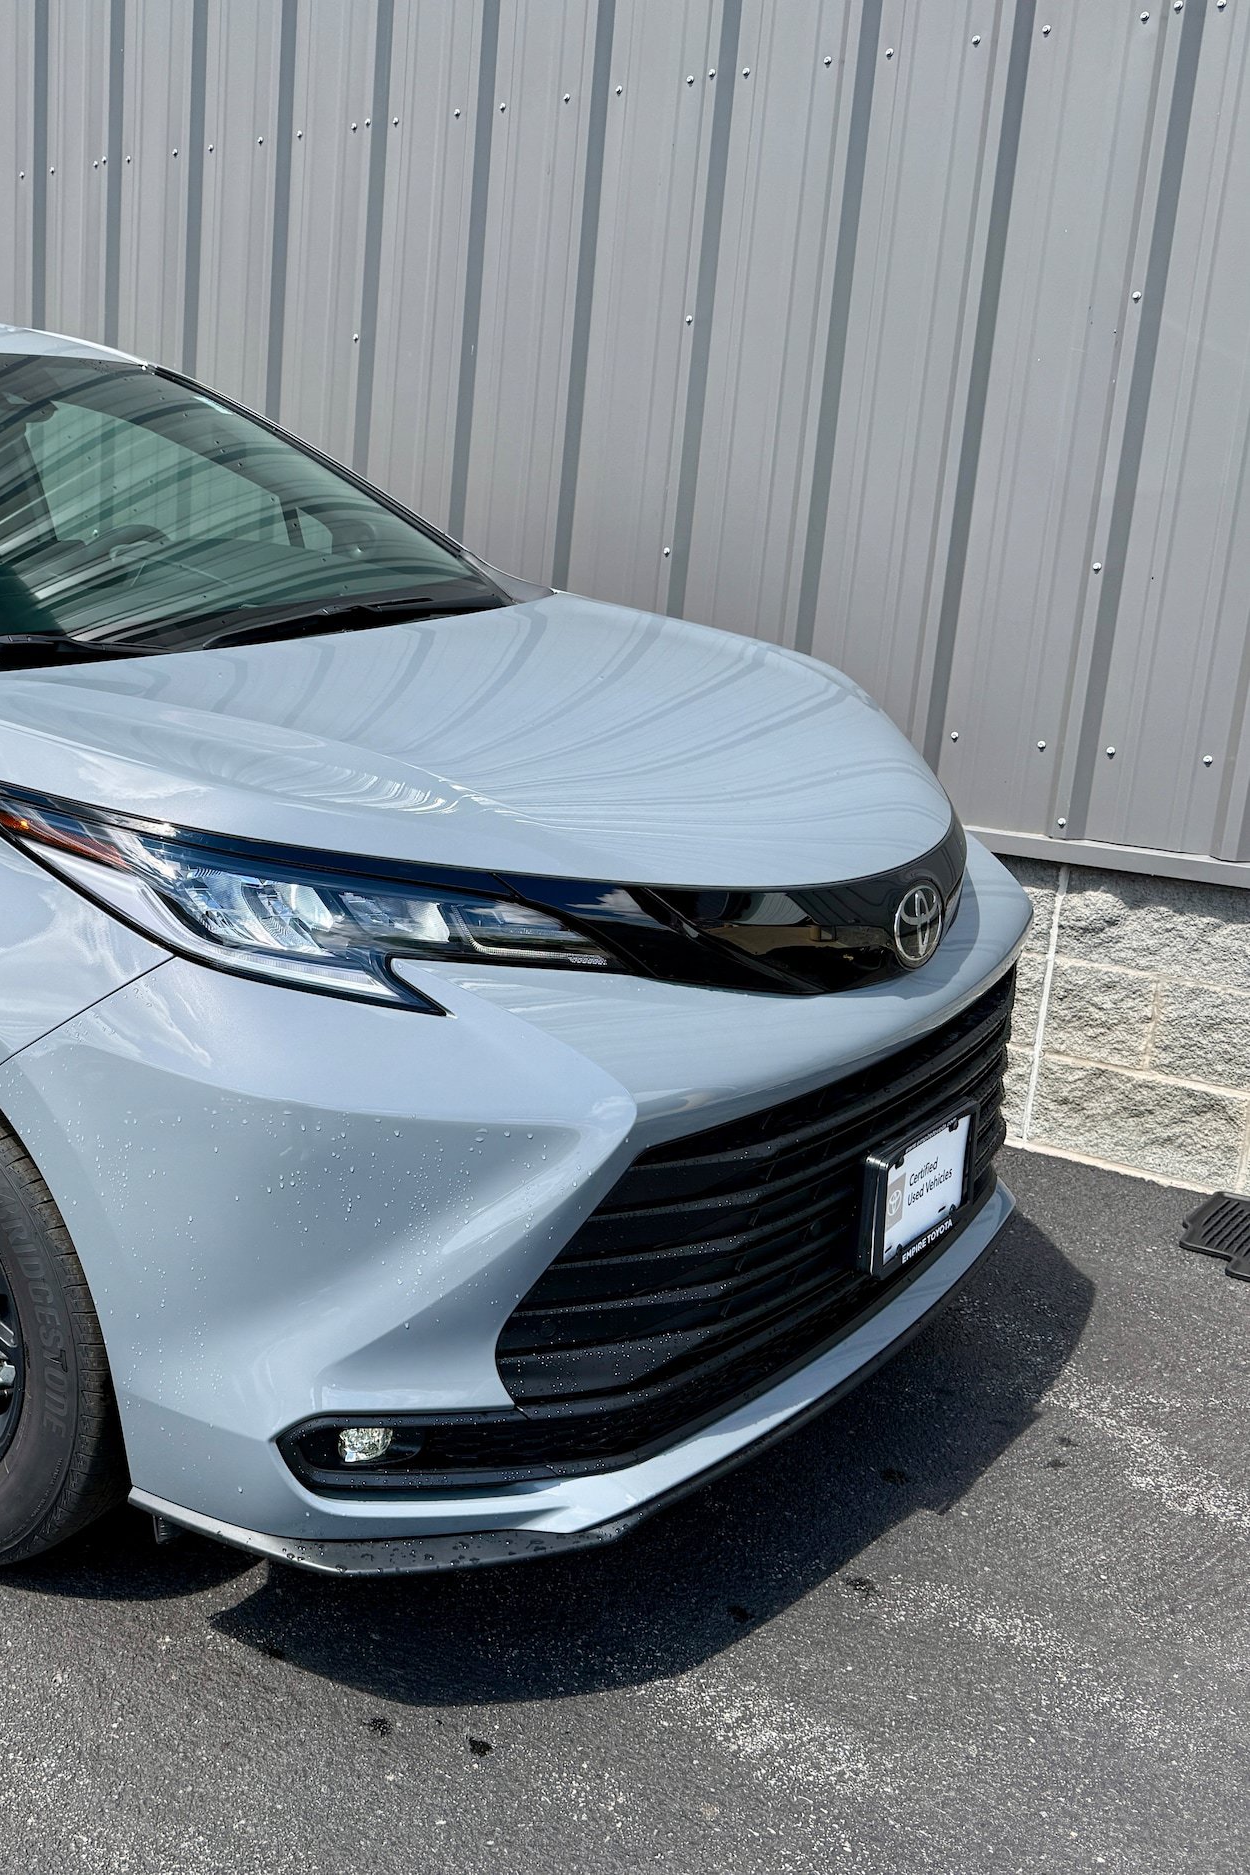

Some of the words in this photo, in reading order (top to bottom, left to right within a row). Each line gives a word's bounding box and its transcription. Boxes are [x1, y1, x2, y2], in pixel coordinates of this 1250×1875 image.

[907, 1184, 925, 1207] Used
[925, 1168, 953, 1193] Vehicles
[909, 1156, 939, 1187] Certified
[902, 1237, 927, 1264] EMPIRE
[926, 1218, 953, 1245] TOYOTA
